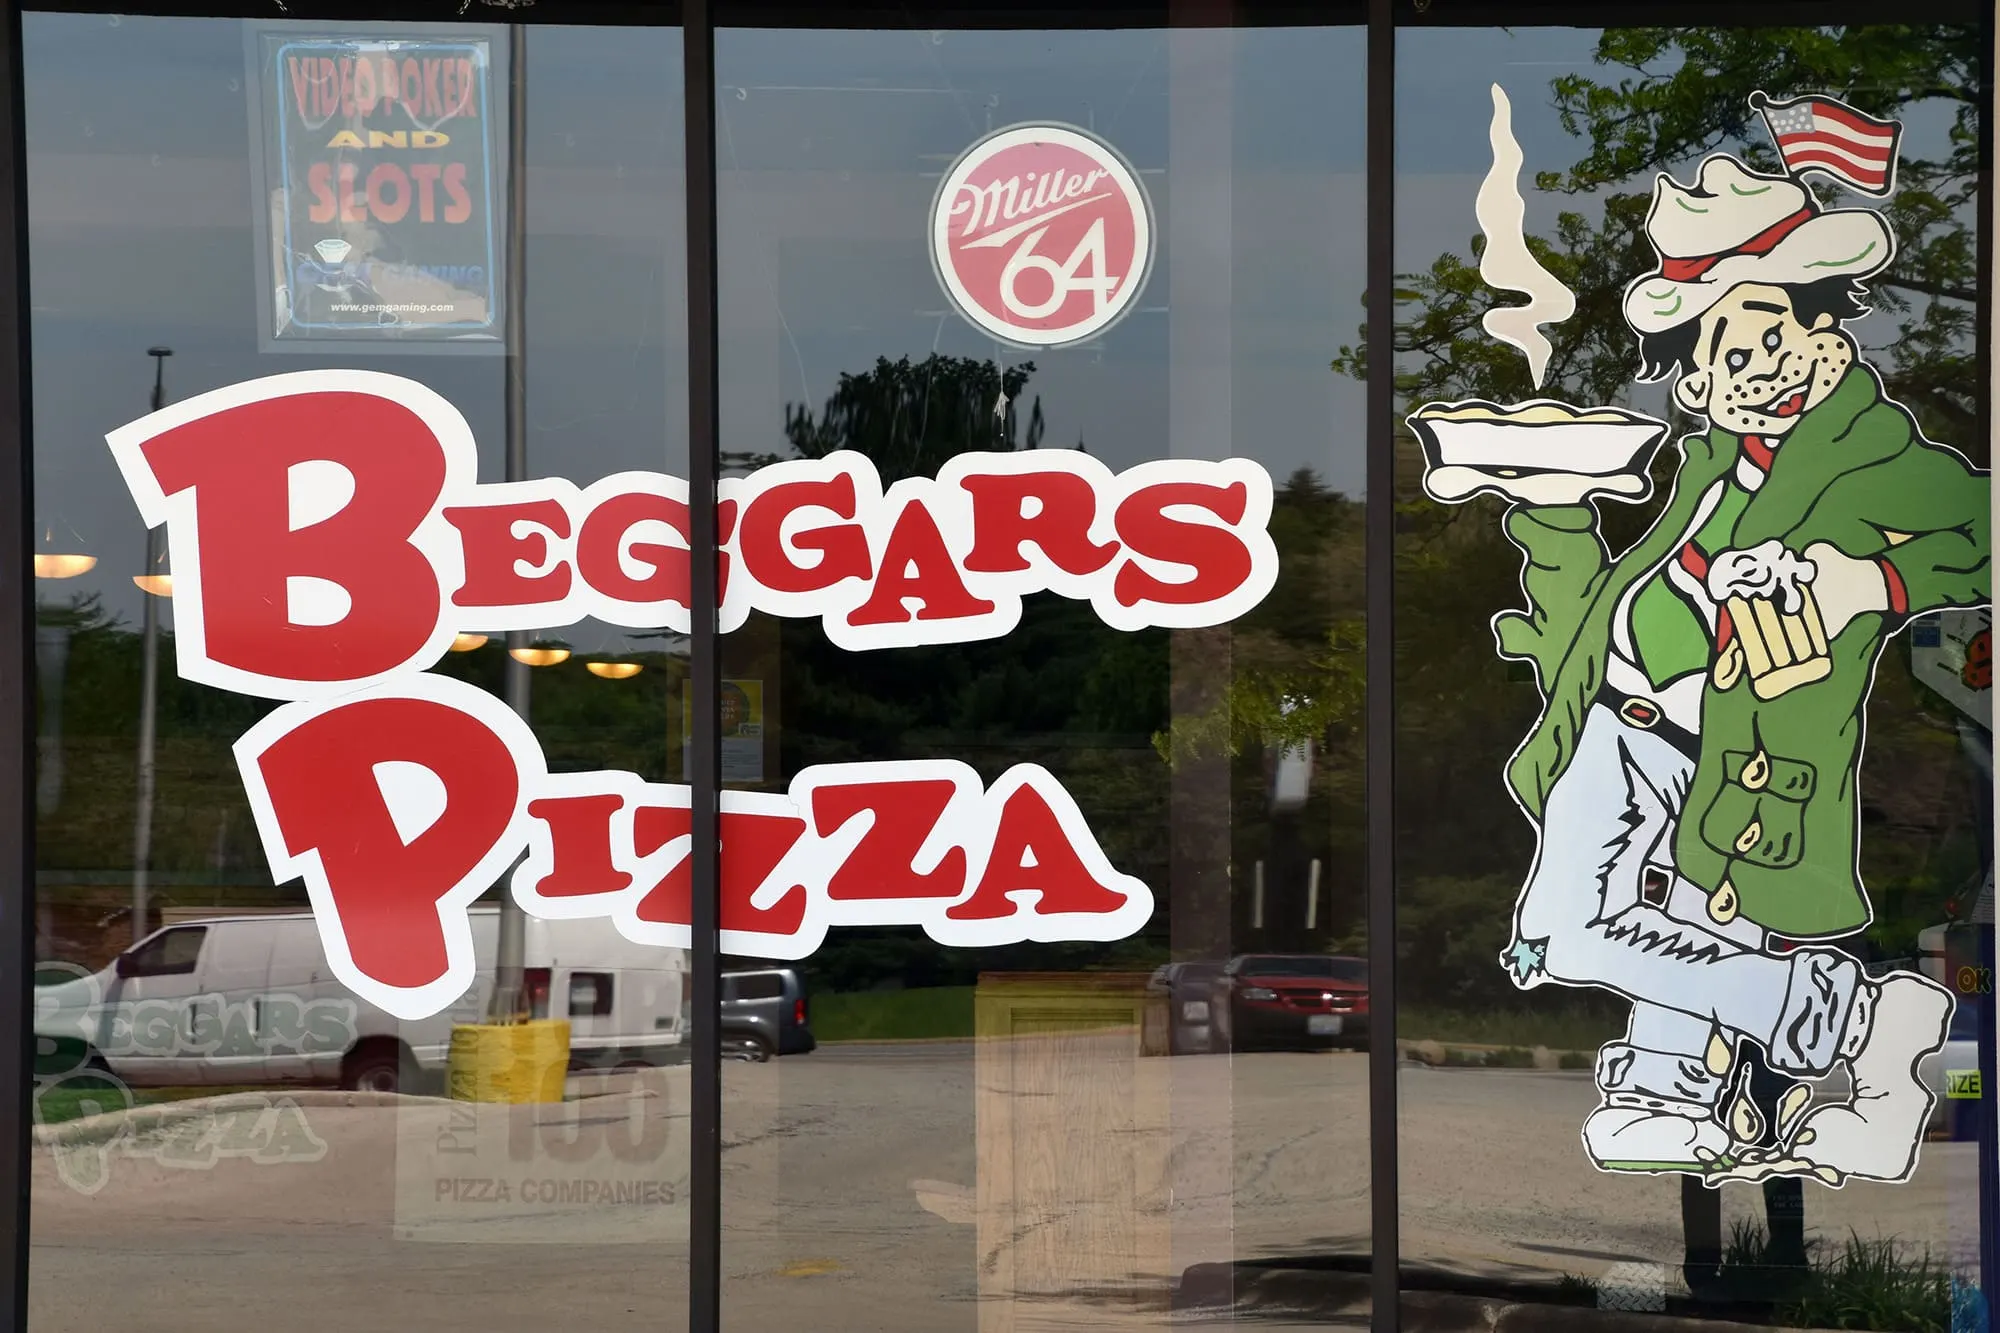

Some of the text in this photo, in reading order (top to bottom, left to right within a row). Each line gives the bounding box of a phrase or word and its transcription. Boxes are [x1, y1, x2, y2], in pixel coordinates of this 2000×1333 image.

[287, 56, 477, 118] VIDEO POKER
[327, 130, 450, 149] AND
[307, 162, 473, 223] SLOTS
[949, 167, 1113, 238] Miller
[1000, 215, 1121, 322] 64
[330, 301, 455, 315] www.gemgaming.com
[436, 1067, 480, 1159] Pizza
[434, 1178, 677, 1206] PIZZA COMPANIES
